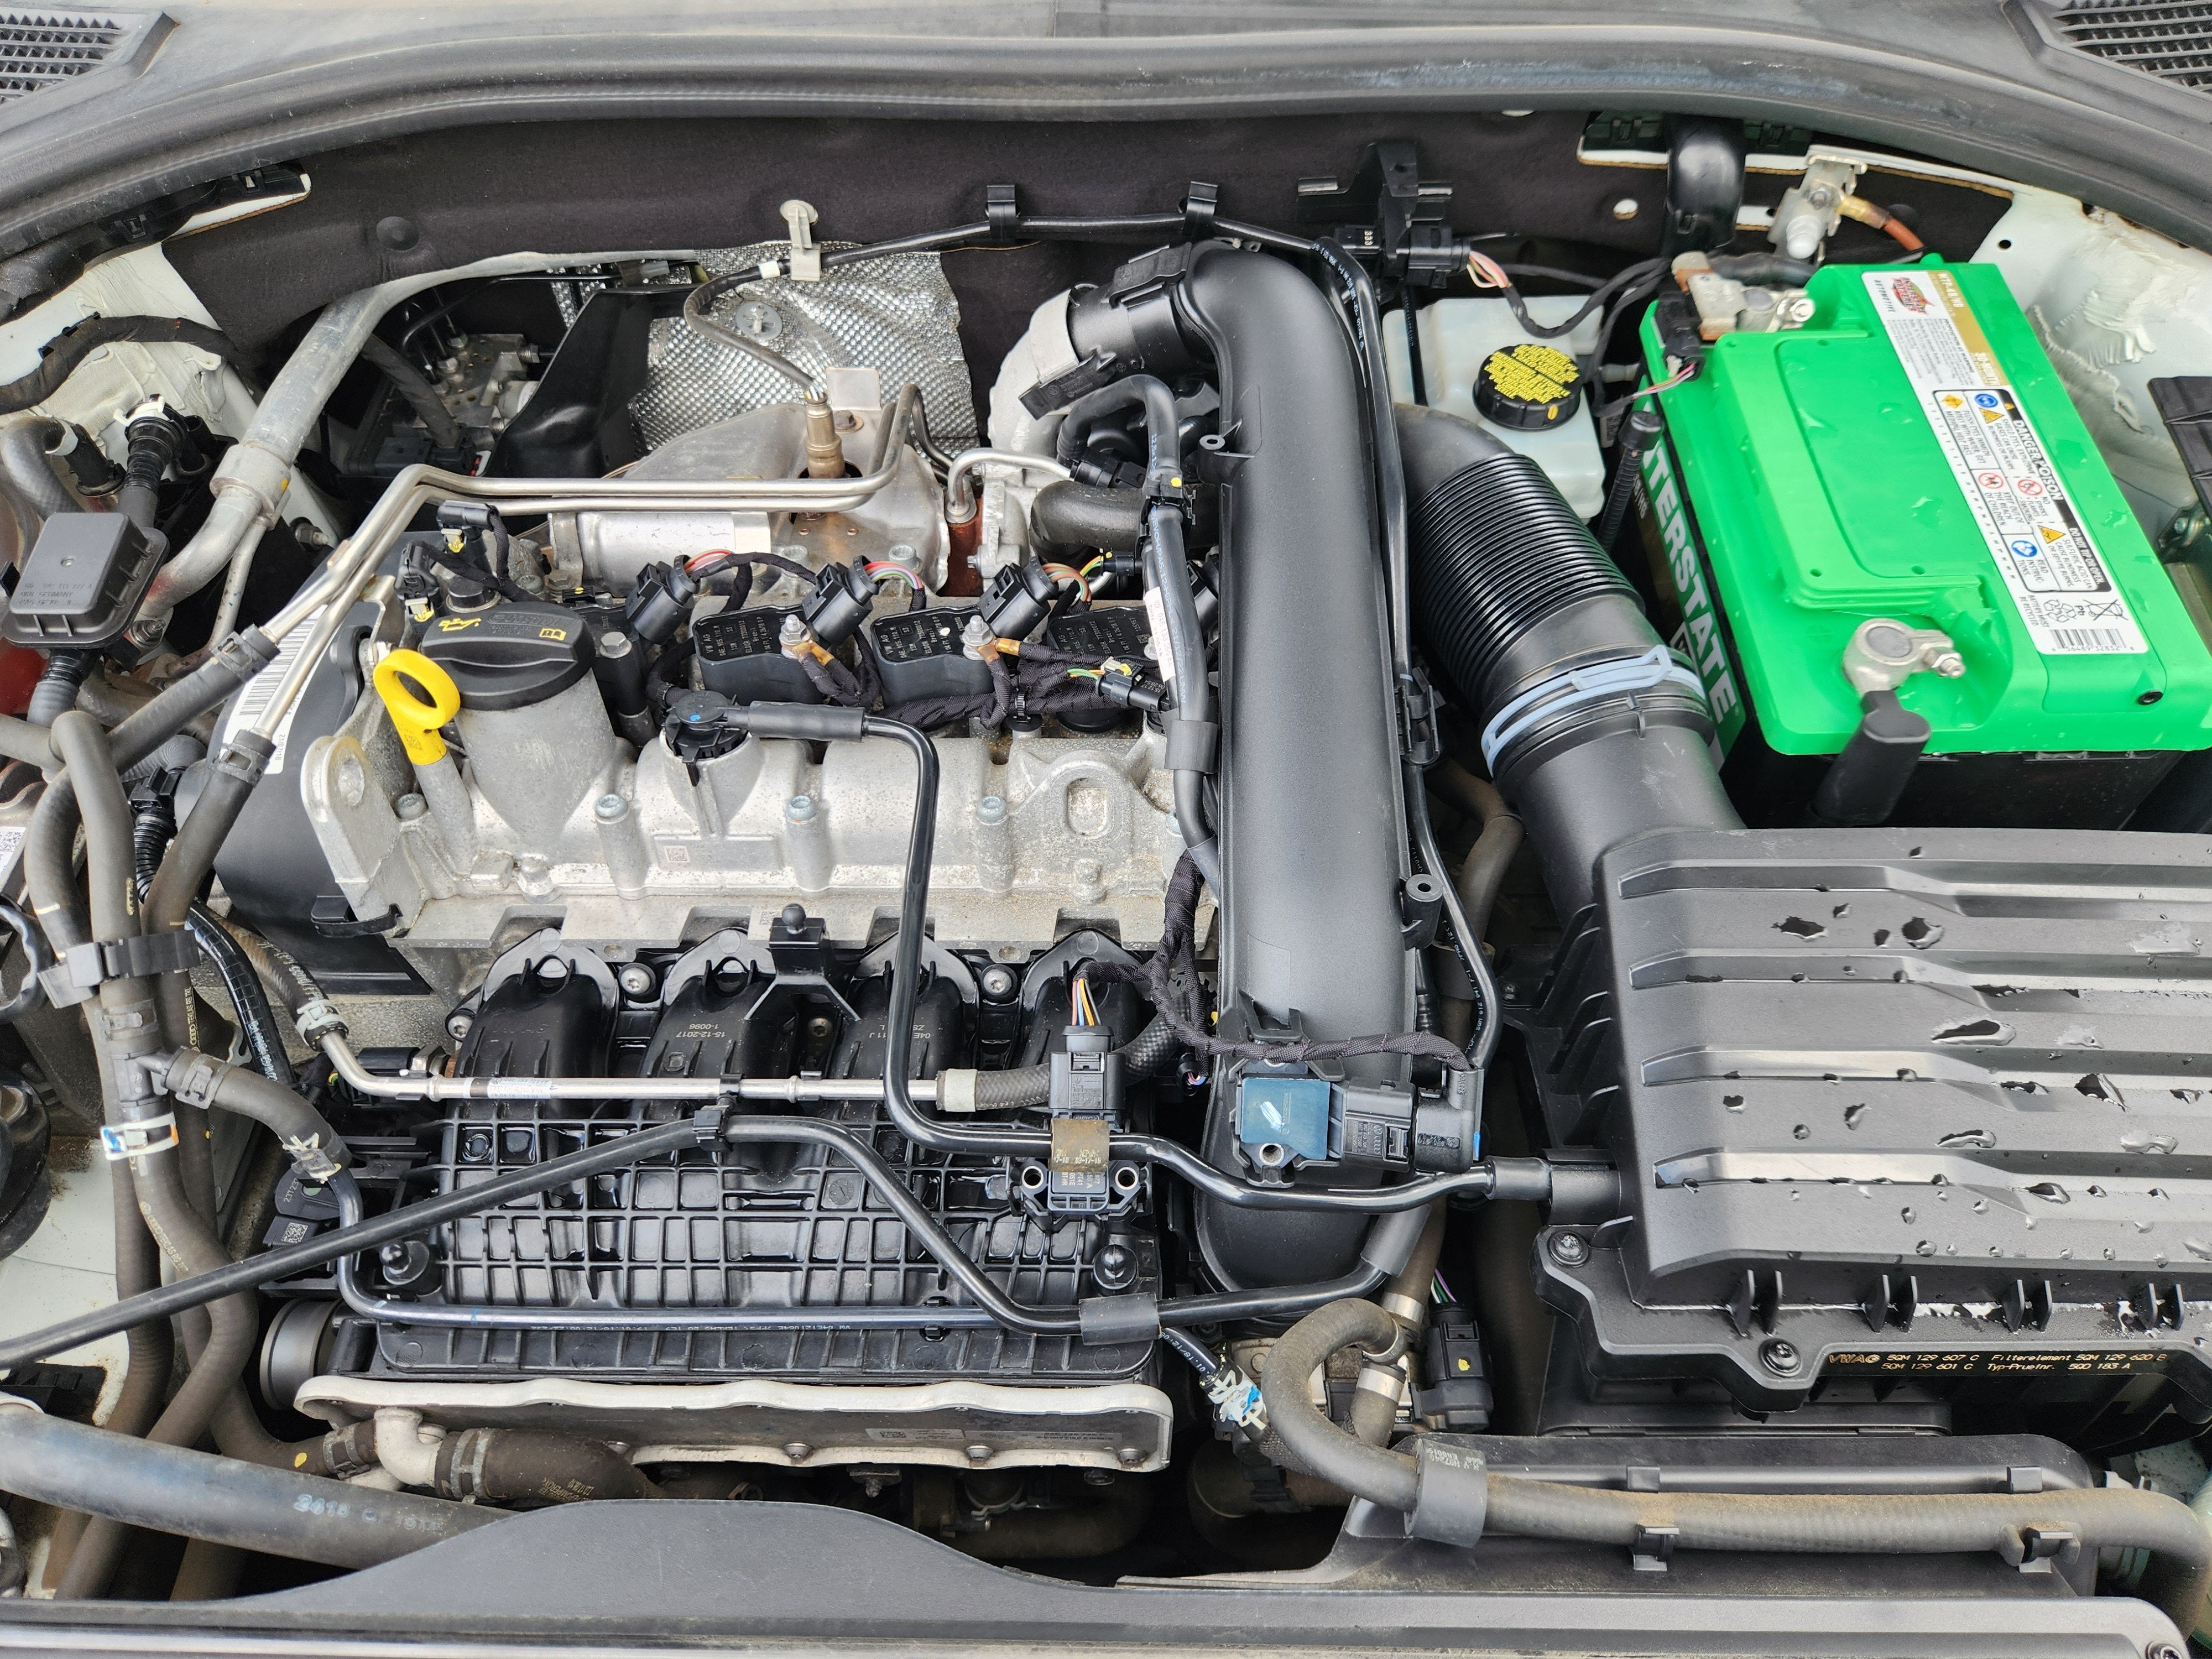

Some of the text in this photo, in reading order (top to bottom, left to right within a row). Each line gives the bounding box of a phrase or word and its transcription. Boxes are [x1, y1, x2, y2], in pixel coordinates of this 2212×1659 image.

[1873, 279, 1896, 312] AUTOMOTIVE
[1954, 431, 1967, 444] HELP
[1994, 422, 2018, 460] GASES CAN CAUSE
[2001, 419, 2015, 434] SHIELD
[2016, 449, 2036, 474] EXPLOSIVE
[1975, 455, 1986, 463] GET
[1993, 492, 2013, 520] THE REACH
[2002, 492, 2014, 503] KEEP
[2009, 505, 2021, 517] OUT
[2068, 527, 2081, 536] DO
[2073, 537, 2088, 548] NOT
[2054, 542, 2081, 583] CAUSE BLINDNESS
[2062, 539, 2095, 589] SULFURIC ACID CAN
[2079, 549, 2093, 558] TIP
[2084, 558, 2097, 567] OR
[2035, 559, 2049, 573] READ
[2021, 602, 2039, 626] RECYCLED
[2027, 594, 2049, 627] BATTERY MUST
[2073, 604, 2087, 615] Pb
[880, 634, 894, 655] VW AG
[274, 733, 286, 761] 21/07/18
[282, 1188, 294, 1203] 23T
[1987, 1363, 2055, 1371] Typ-Pruefnr.
